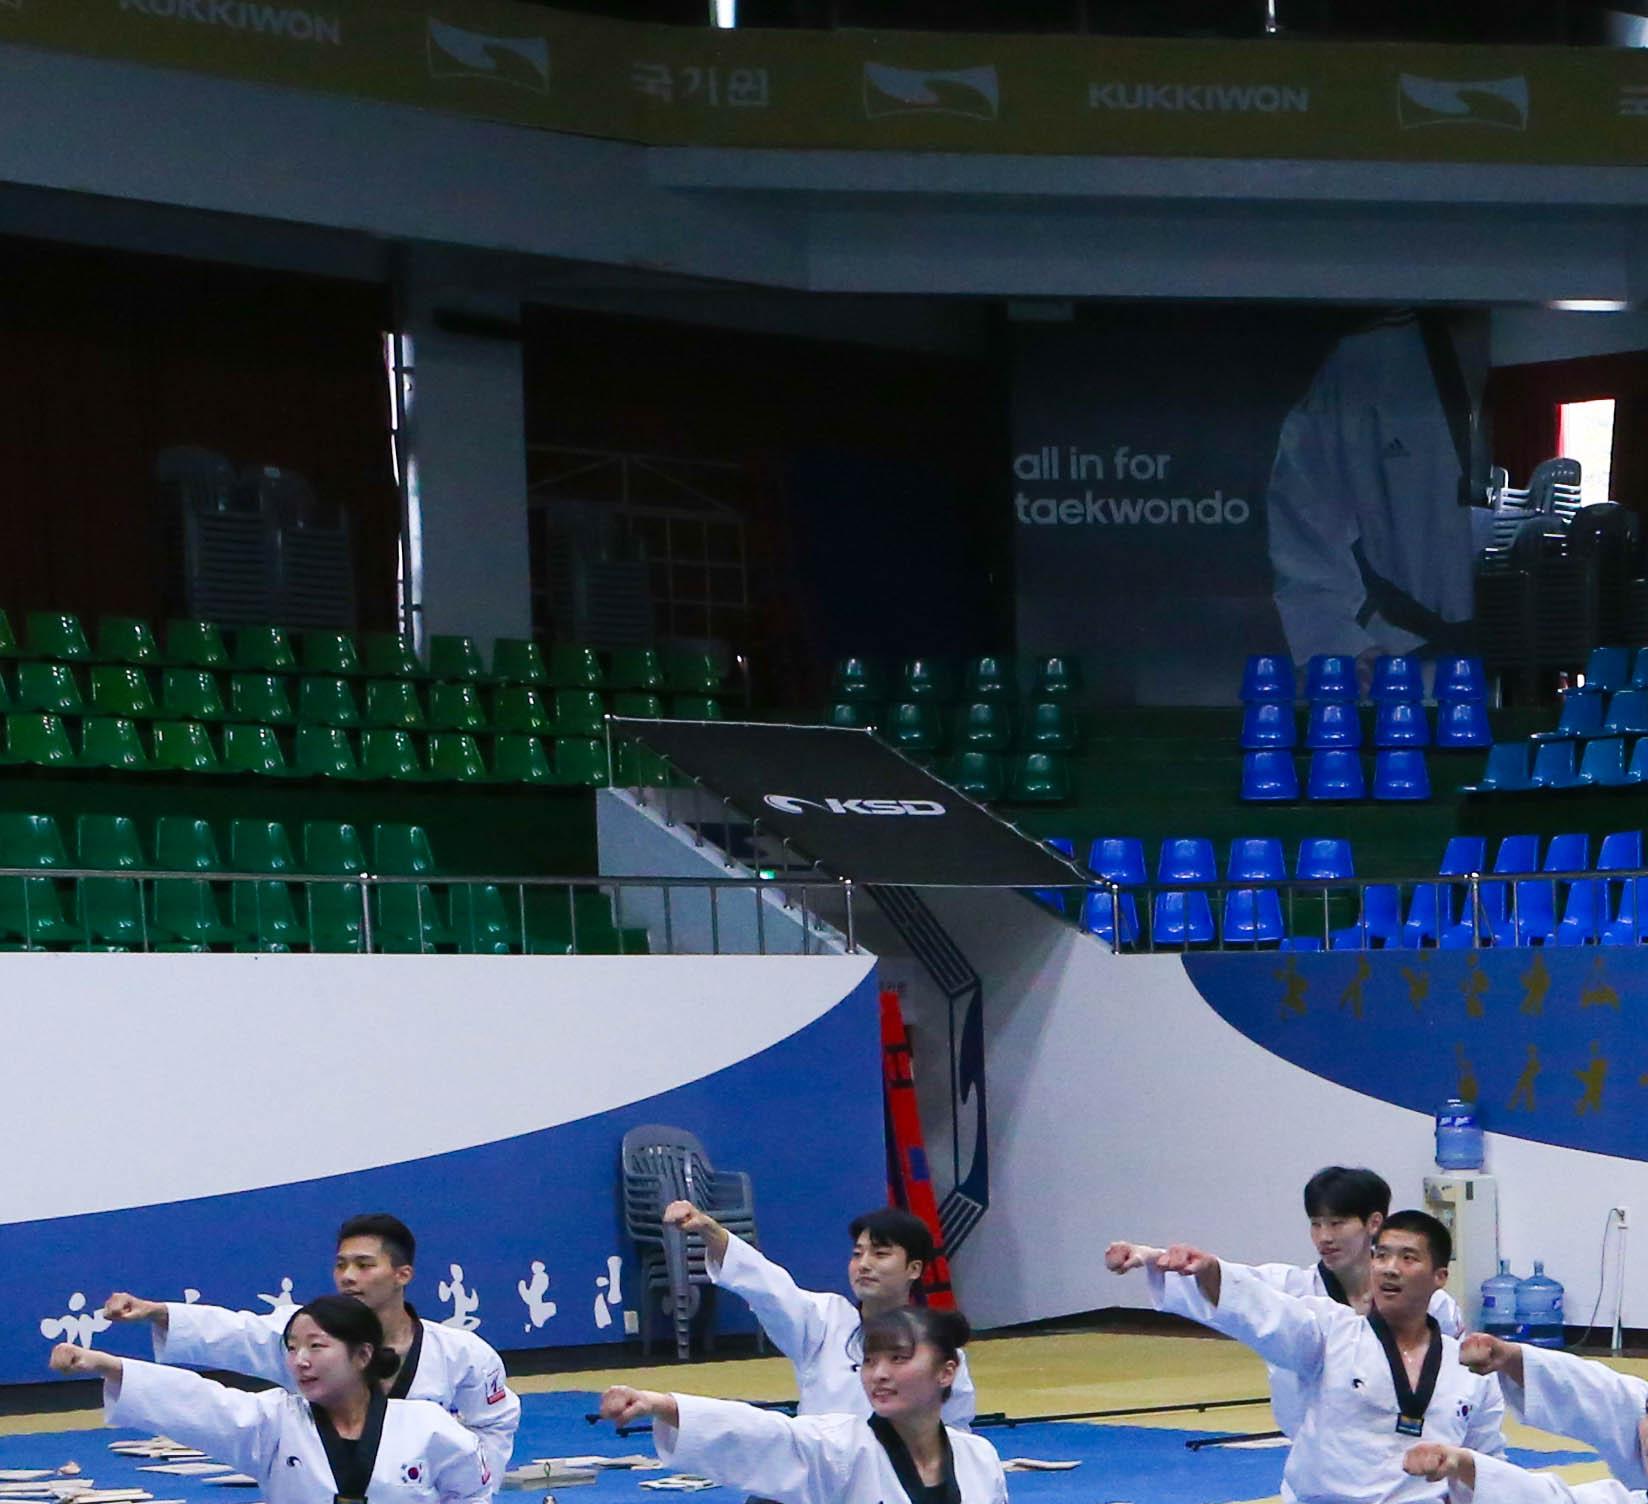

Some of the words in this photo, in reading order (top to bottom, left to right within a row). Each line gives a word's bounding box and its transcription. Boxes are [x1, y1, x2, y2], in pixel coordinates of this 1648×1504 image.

[632, 63, 771, 108] 국기원
[1088, 83, 1309, 113] KUKKIWON
[1014, 446, 1060, 480] all
[1070, 446, 1104, 480] in
[1113, 446, 1171, 480] for
[1016, 490, 1250, 525] taekwondo
[824, 798, 947, 816] KSD
